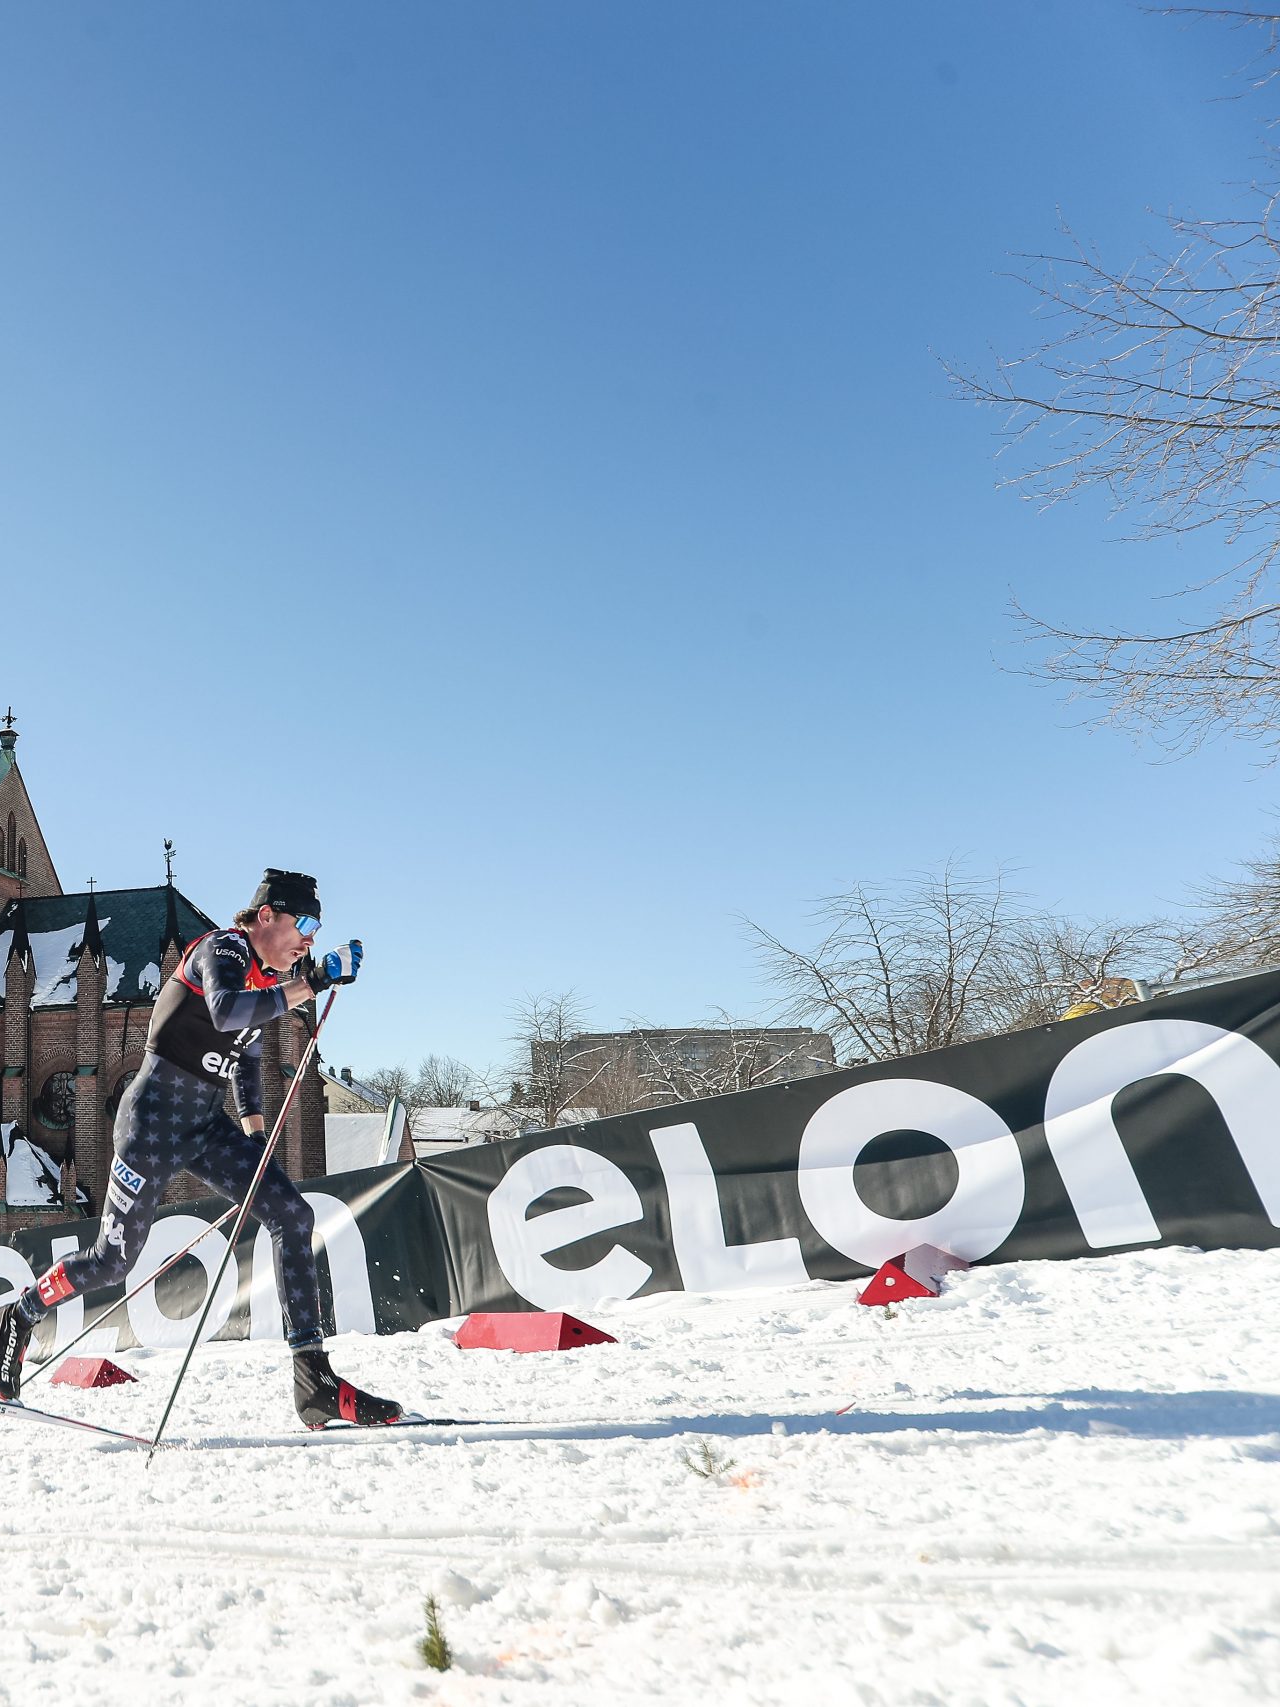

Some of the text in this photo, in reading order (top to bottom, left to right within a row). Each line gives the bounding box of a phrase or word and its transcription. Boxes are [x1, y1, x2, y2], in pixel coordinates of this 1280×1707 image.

[114, 1158, 142, 1191] VISA
[40, 1277, 55, 1299] 11
[0, 1317, 17, 1383] MADSHUS
